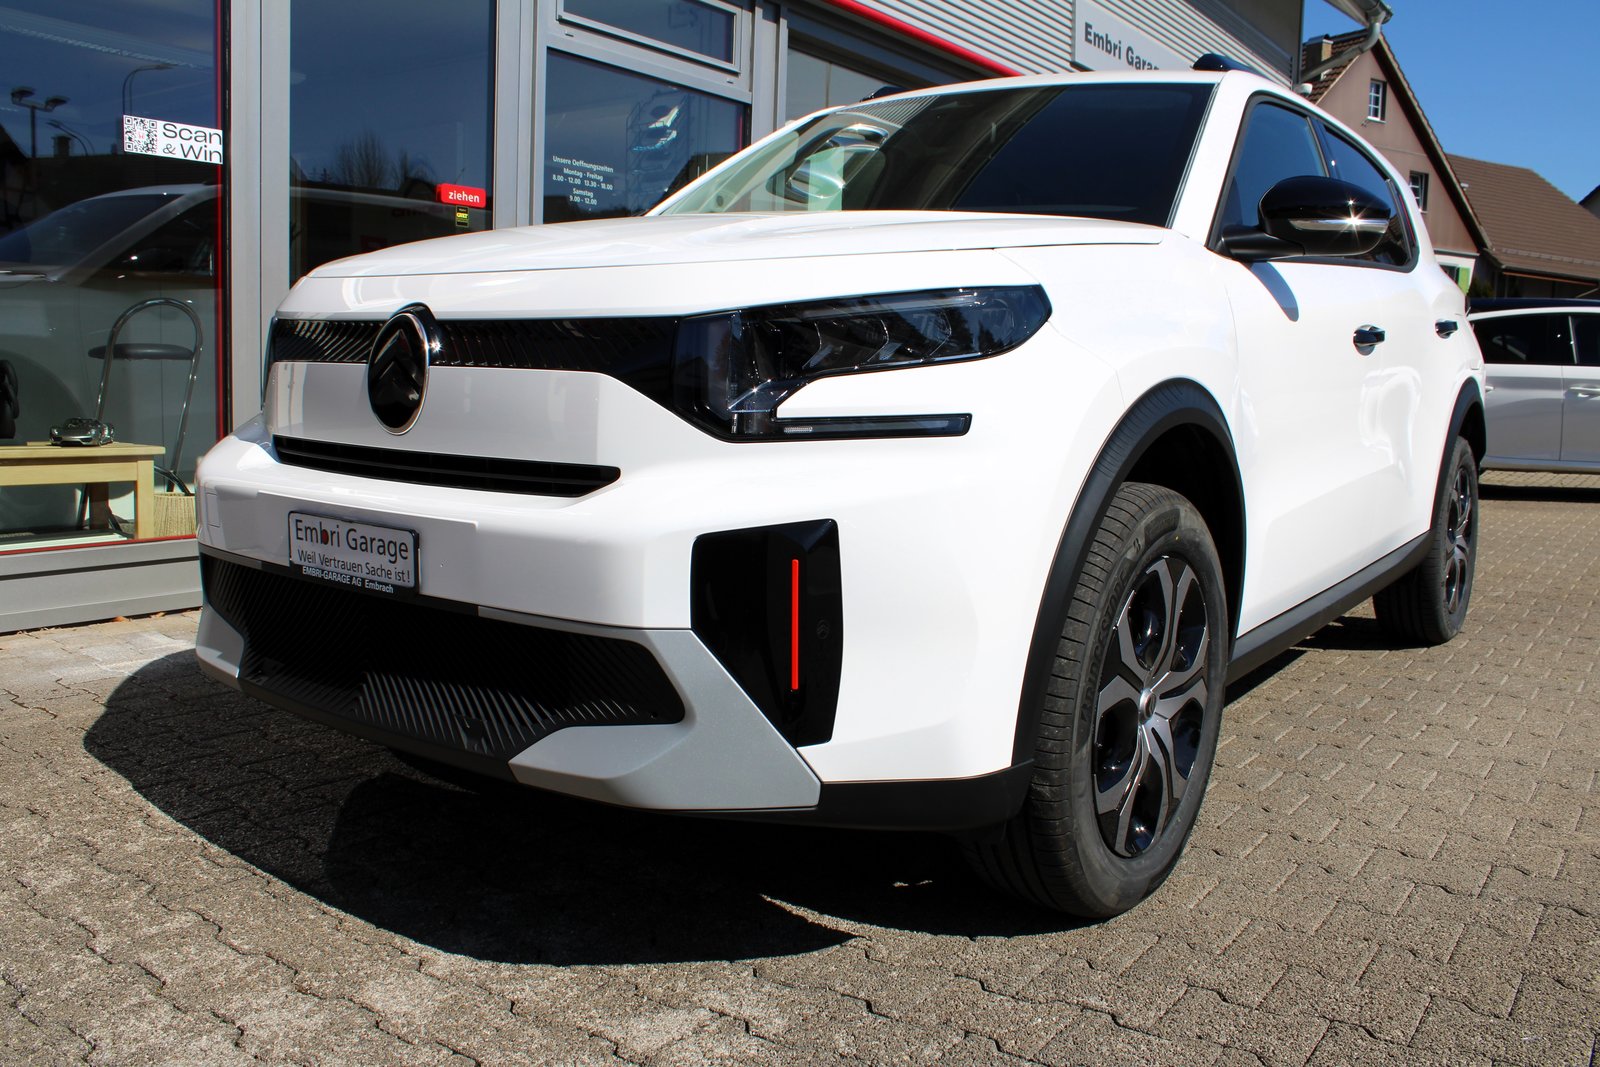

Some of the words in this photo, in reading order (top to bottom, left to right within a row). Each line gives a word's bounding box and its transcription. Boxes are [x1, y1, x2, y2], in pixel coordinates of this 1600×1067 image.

[1084, 21, 1122, 60] Embri
[1126, 46, 1160, 70] Gara
[163, 123, 222, 145] Scan
[163, 143, 176, 155] &
[180, 143, 222, 163] Win
[552, 155, 571, 165] Unsere
[572, 159, 614, 173] Oeffnungszeiten
[552, 174, 564, 182] 8.00
[568, 177, 581, 185] 12.00
[584, 179, 597, 188] 13.30
[563, 167, 583, 179] Montag
[586, 171, 604, 182] Freitag
[448, 190, 480, 203] ziehen
[569, 195, 580, 203] 9.00
[584, 197, 597, 206] 12.00
[572, 188, 594, 198] Samstag
[295, 519, 340, 547] Embri
[346, 528, 409, 564] Garage
[298, 549, 316, 565] Weil
[318, 552, 363, 574] Vertrauen
[365, 562, 392, 580] Sache
[302, 566, 350, 583] EMBRI-GARAGE
[351, 576, 362, 587] AG
[365, 579, 394, 594] Embrach
